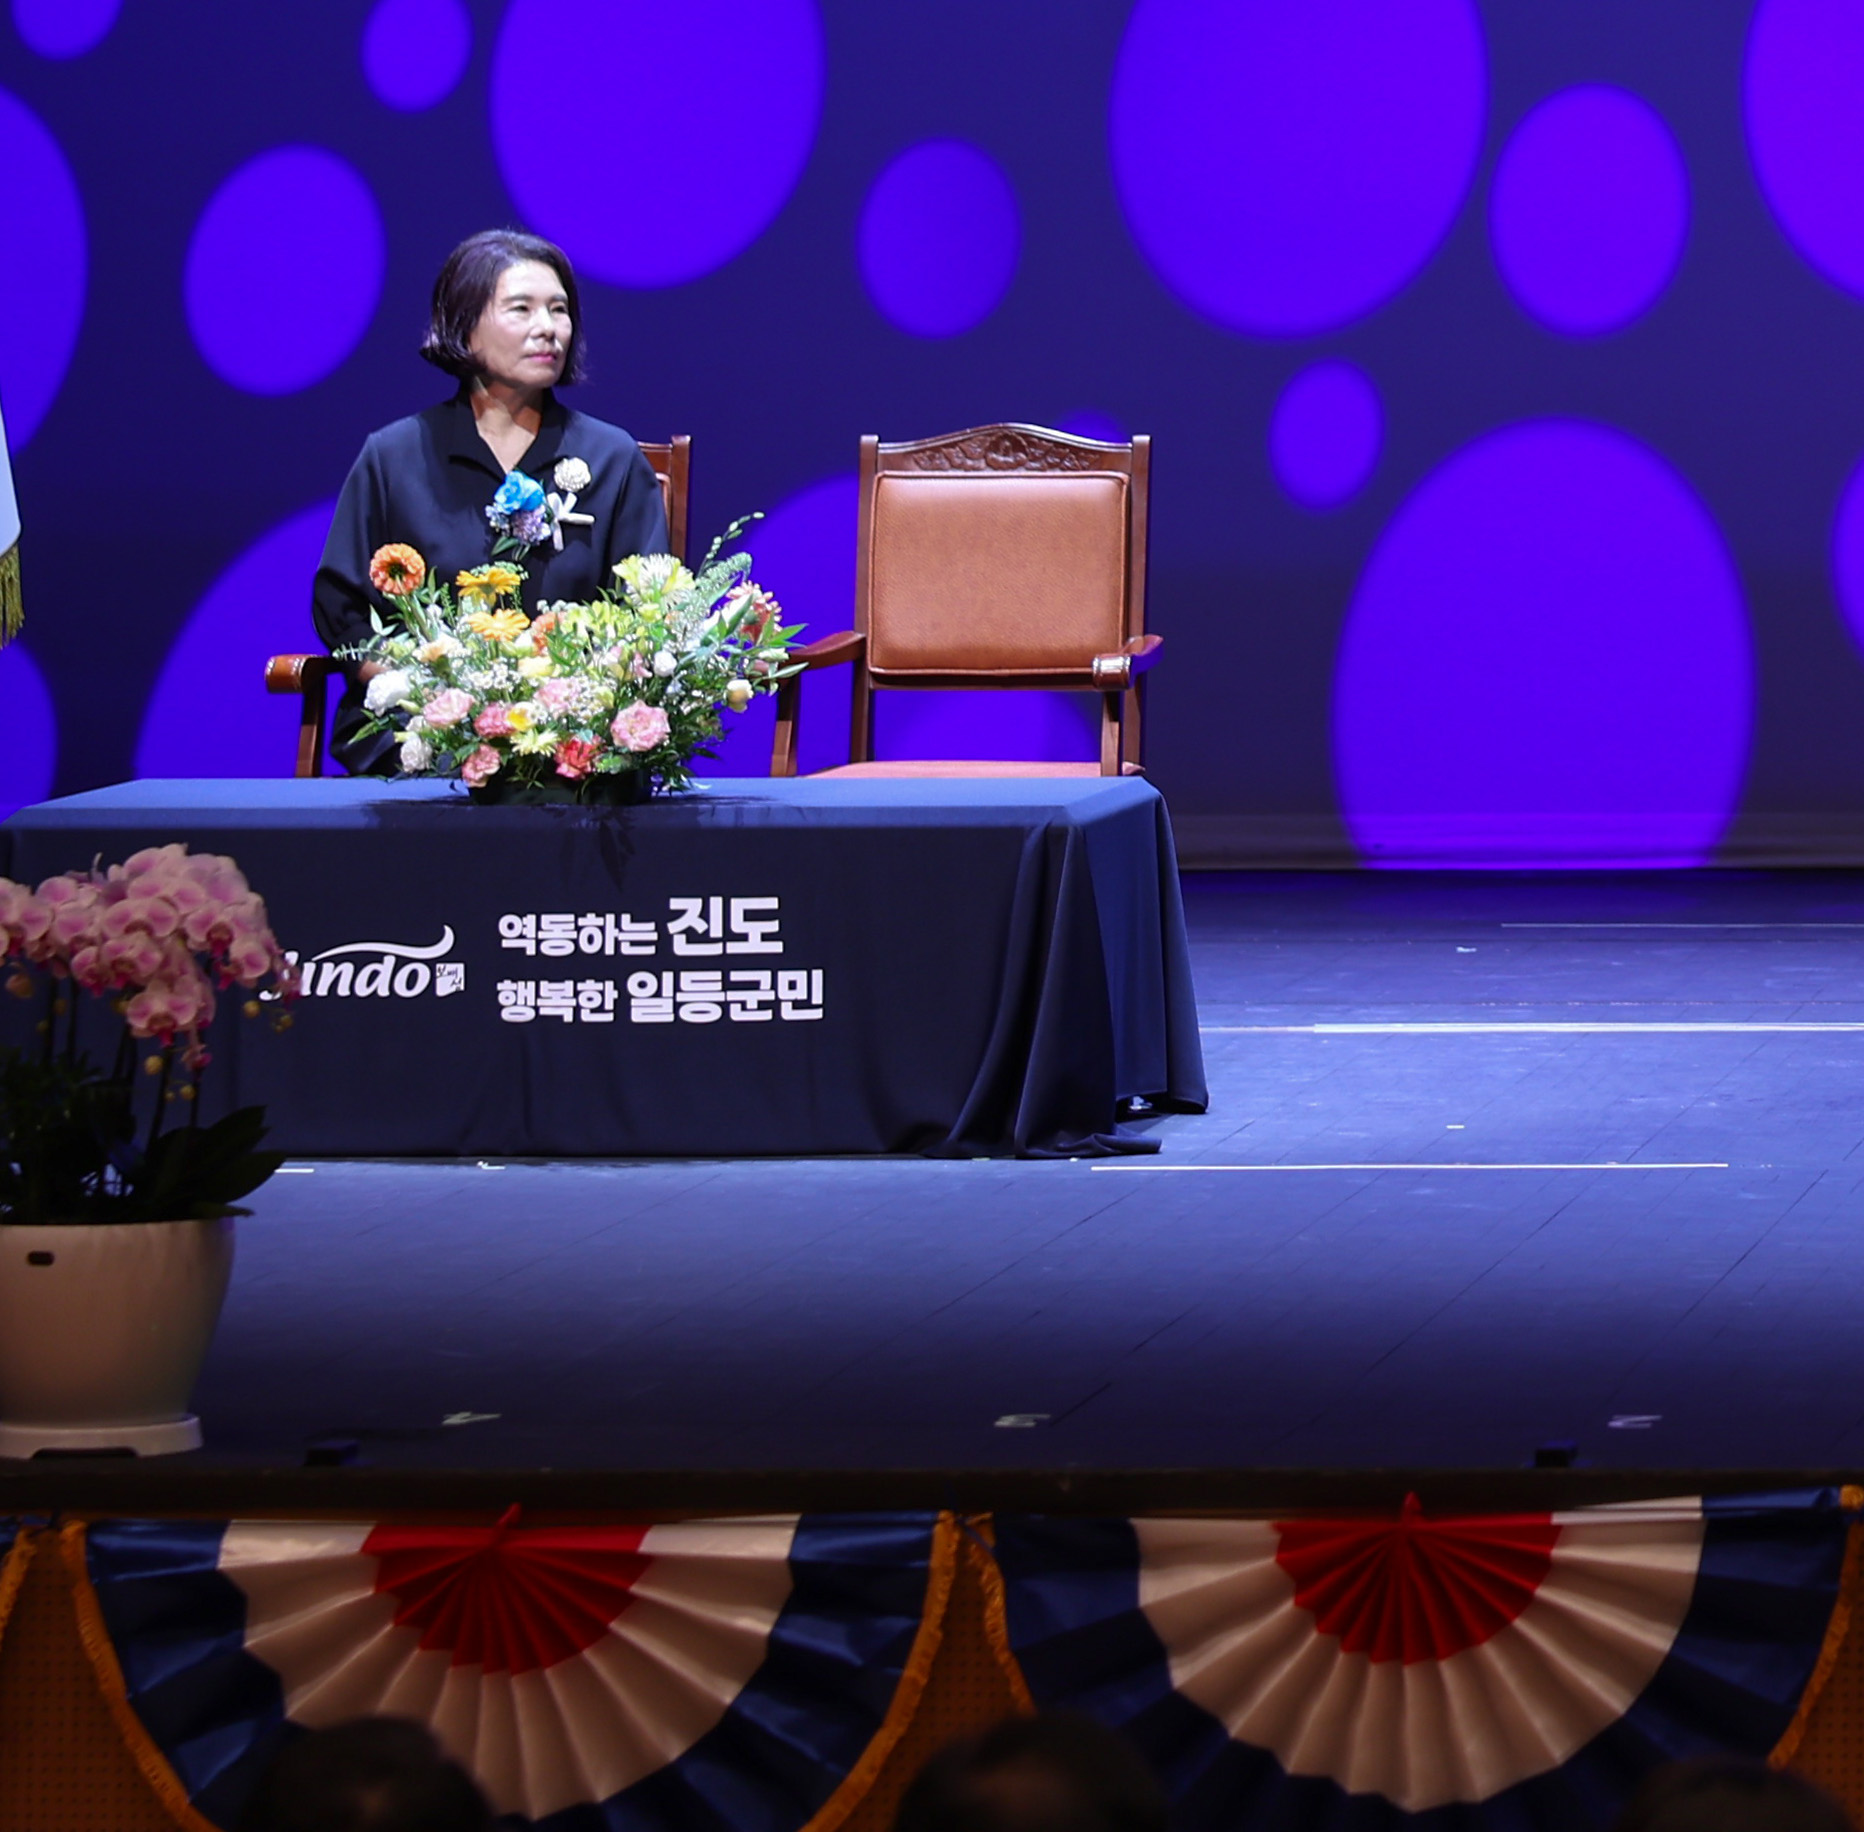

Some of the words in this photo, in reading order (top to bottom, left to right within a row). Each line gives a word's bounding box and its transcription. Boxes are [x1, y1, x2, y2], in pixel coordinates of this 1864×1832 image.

[498, 912, 658, 956] 역동하는
[666, 896, 784, 956] 진도
[496, 979, 619, 1023] 행복한
[626, 969, 824, 1023] 일등군민
